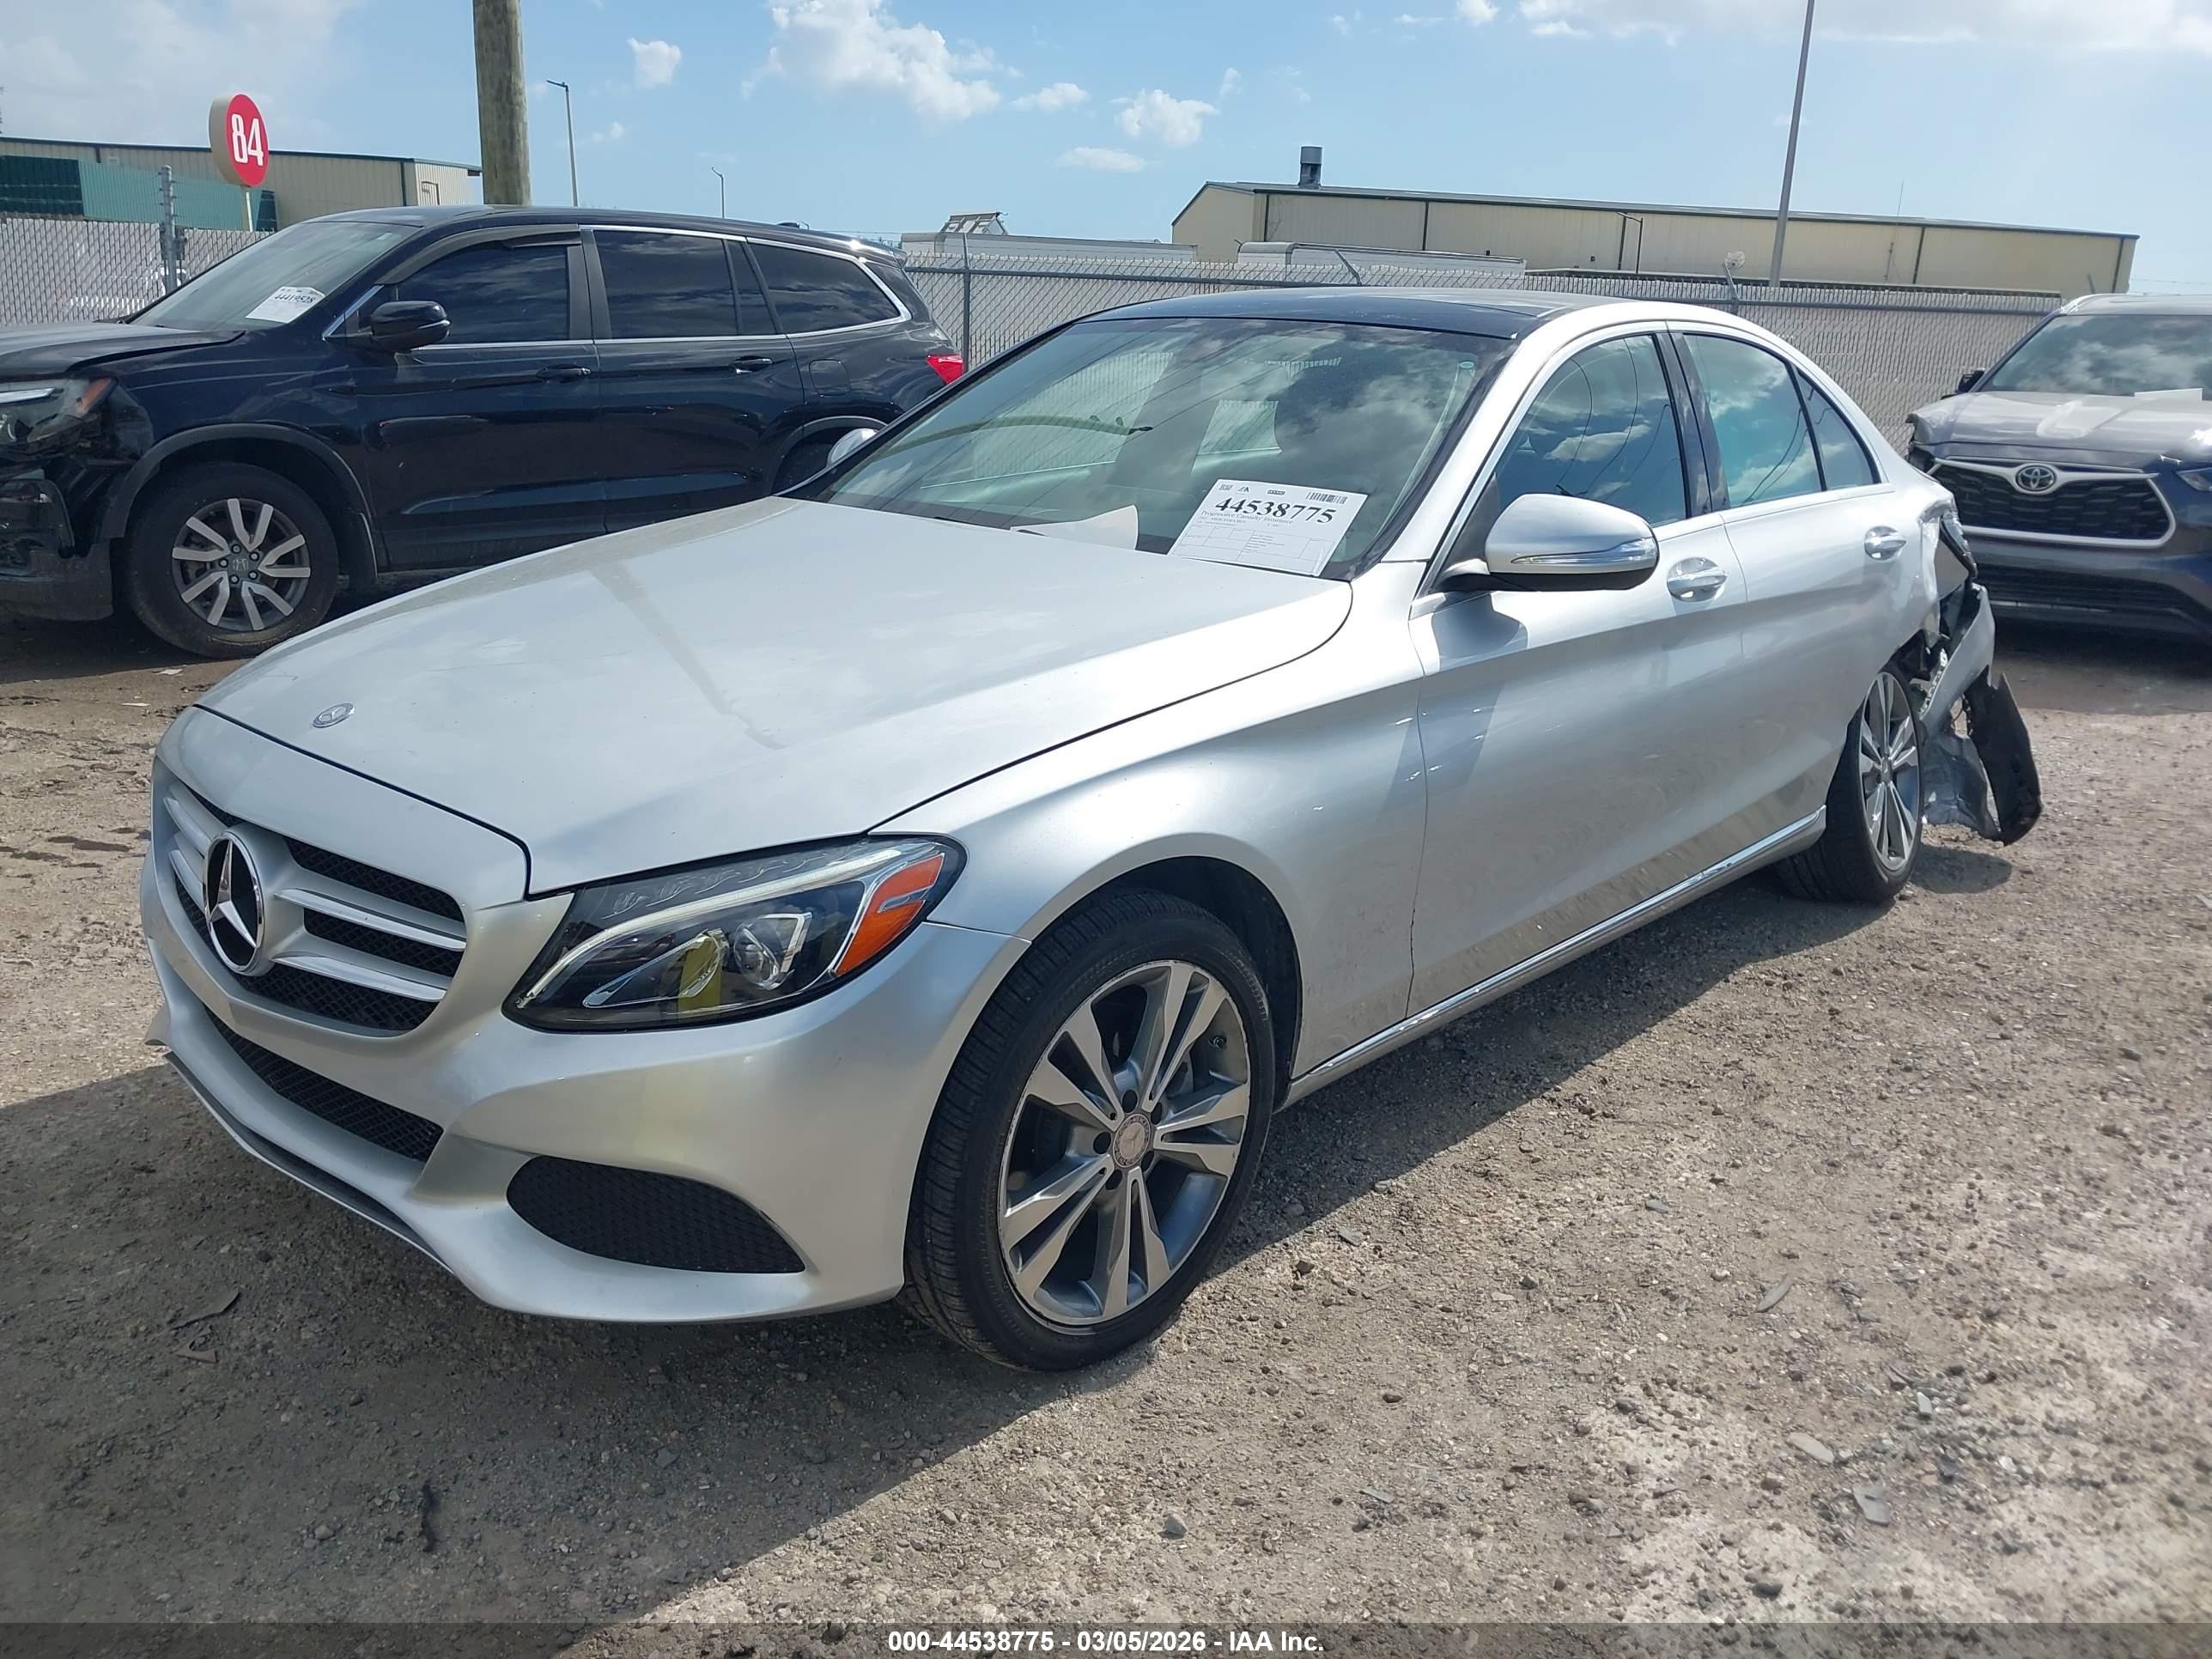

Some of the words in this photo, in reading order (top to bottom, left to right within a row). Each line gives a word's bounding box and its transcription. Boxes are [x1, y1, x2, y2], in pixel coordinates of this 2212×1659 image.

[231, 113, 264, 166] 84
[1201, 510, 1236, 519] Progressive
[1237, 513, 1264, 521] Casualty
[1263, 515, 1294, 525] Insurance
[1215, 497, 1337, 524] 44538775
